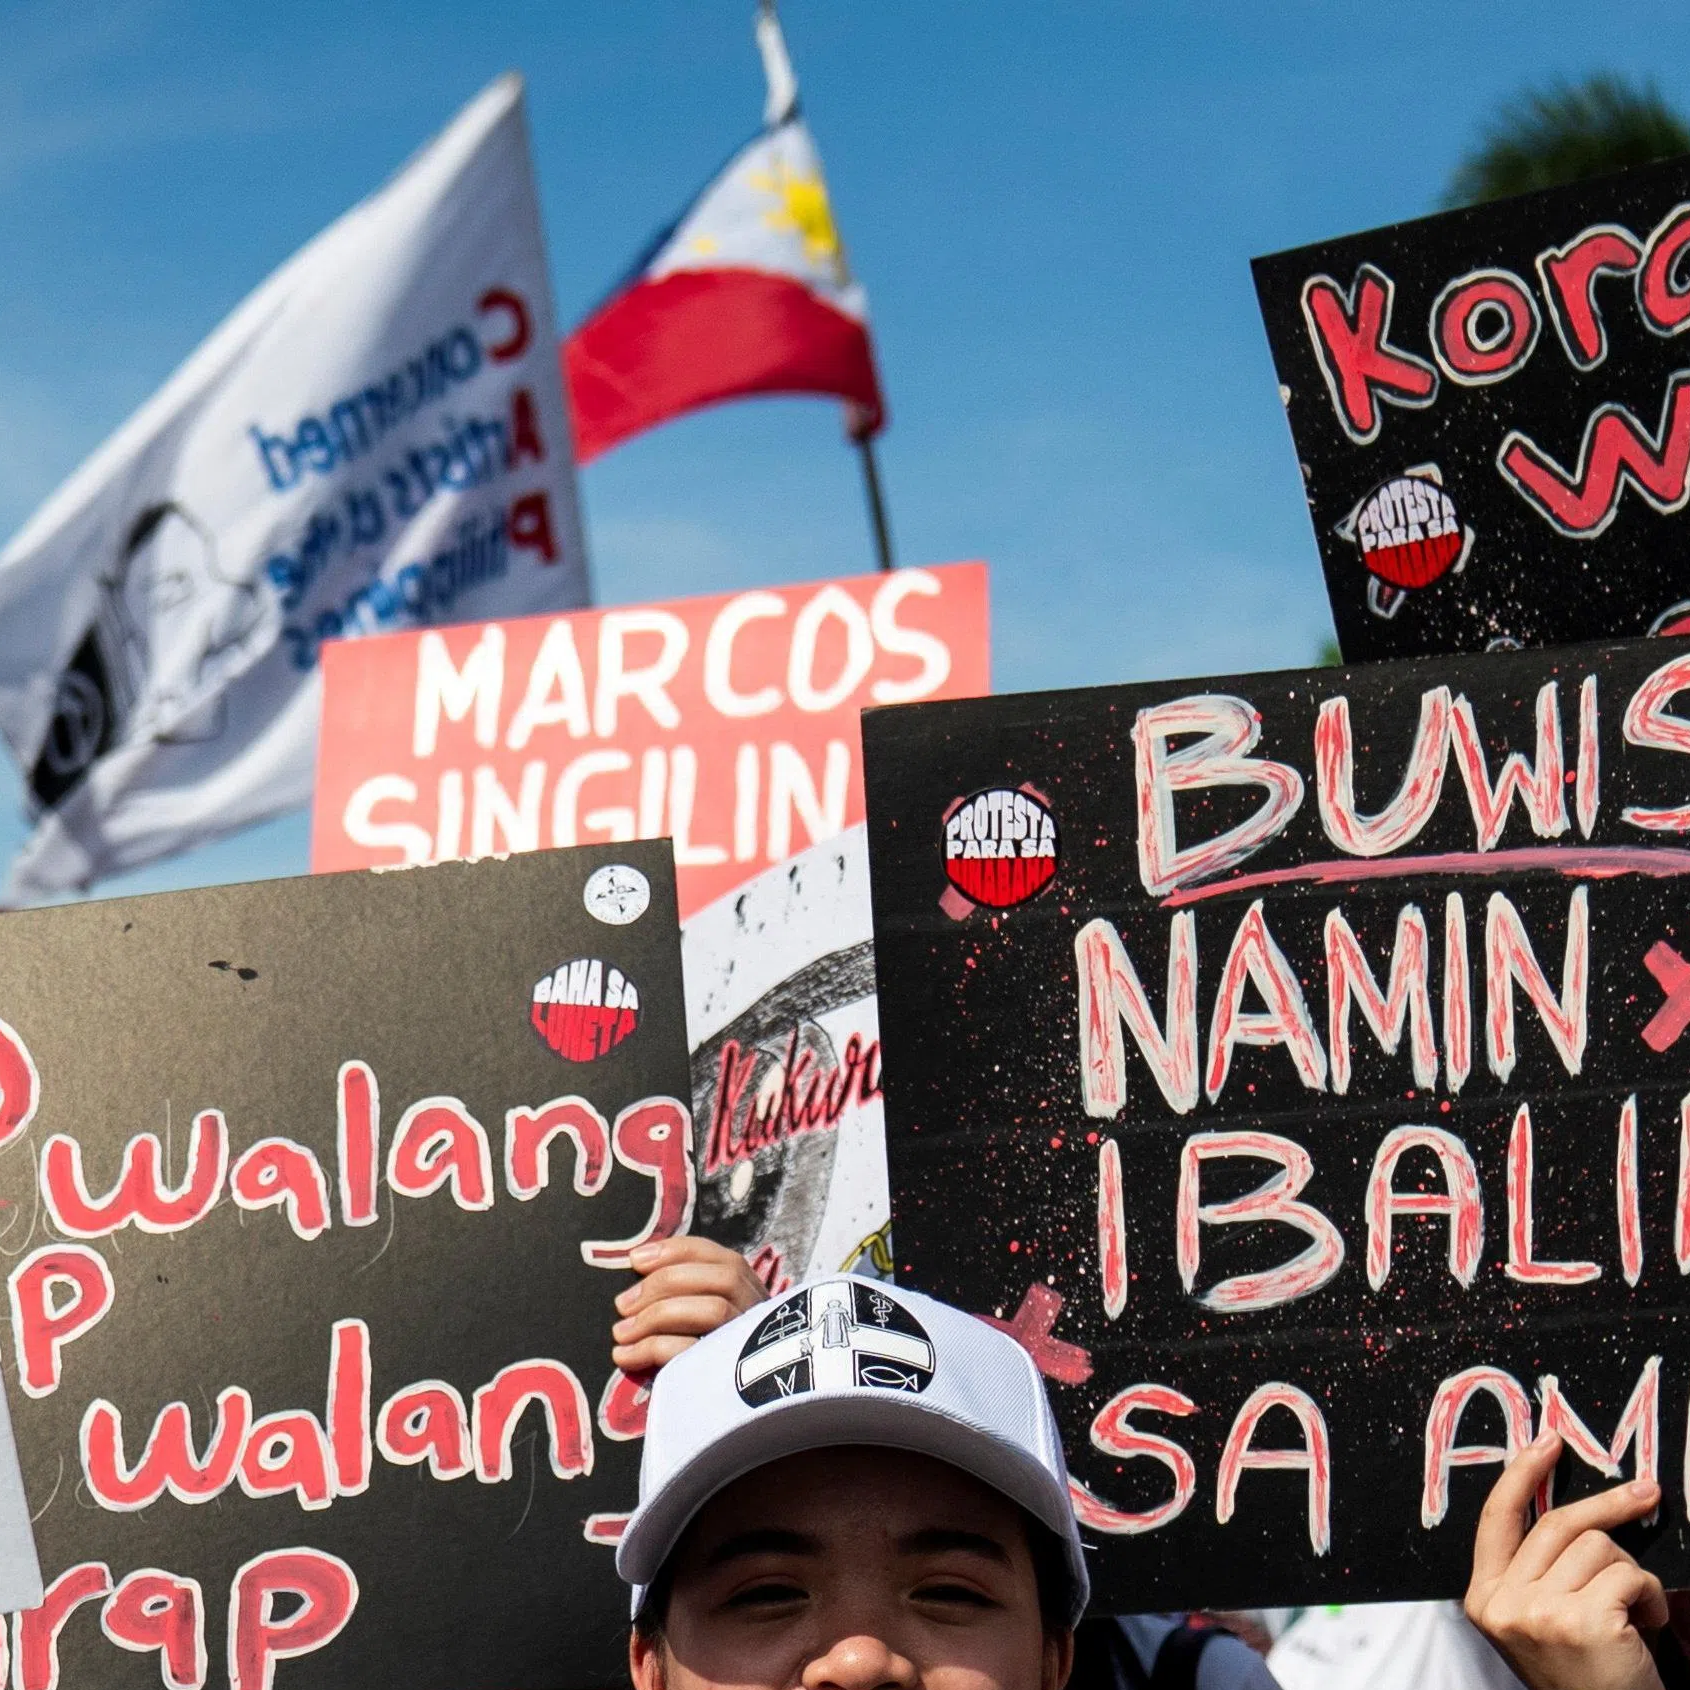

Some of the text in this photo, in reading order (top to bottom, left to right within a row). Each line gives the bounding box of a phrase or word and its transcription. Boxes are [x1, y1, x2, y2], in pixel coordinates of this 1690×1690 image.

[1358, 479, 1456, 536] PROTESTA
[1361, 516, 1459, 554] PARA SA
[410, 564, 953, 758] MARCOS
[946, 790, 1056, 841] PROTESTA
[947, 838, 1056, 859] PARA SA
[533, 958, 639, 1011] BAHA SA
[1075, 885, 1591, 1118] NAMIN
[531, 1001, 638, 1063] LUNETA
[40, 1059, 696, 1269] walang
[1069, 1380, 1331, 1558] SA
